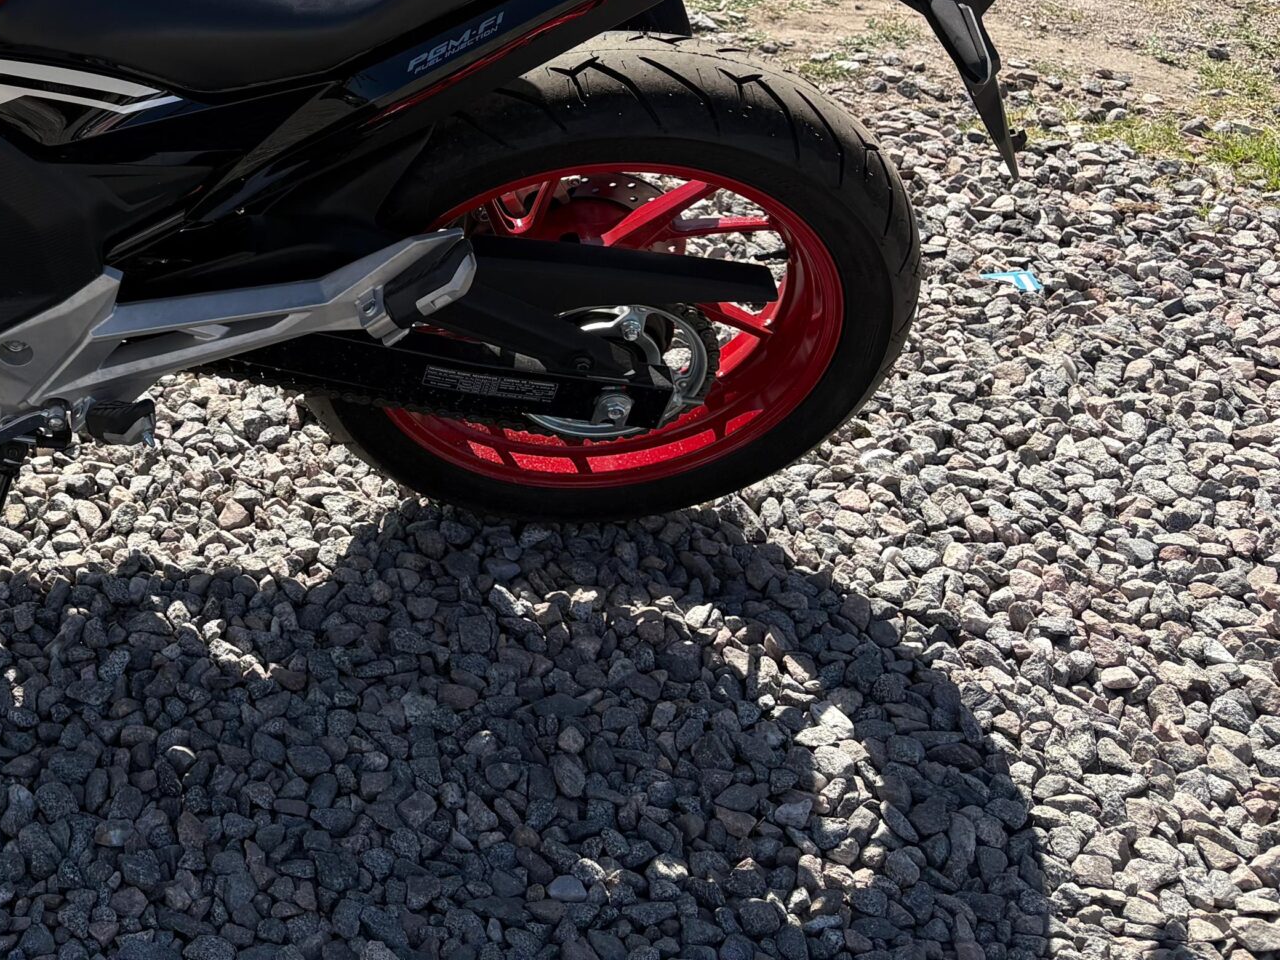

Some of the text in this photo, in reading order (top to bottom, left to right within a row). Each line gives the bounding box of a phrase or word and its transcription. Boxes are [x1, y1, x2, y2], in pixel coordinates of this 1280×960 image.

[407, 10, 505, 73] PGM-FI
[414, 26, 499, 75] FUEL INJECTION
